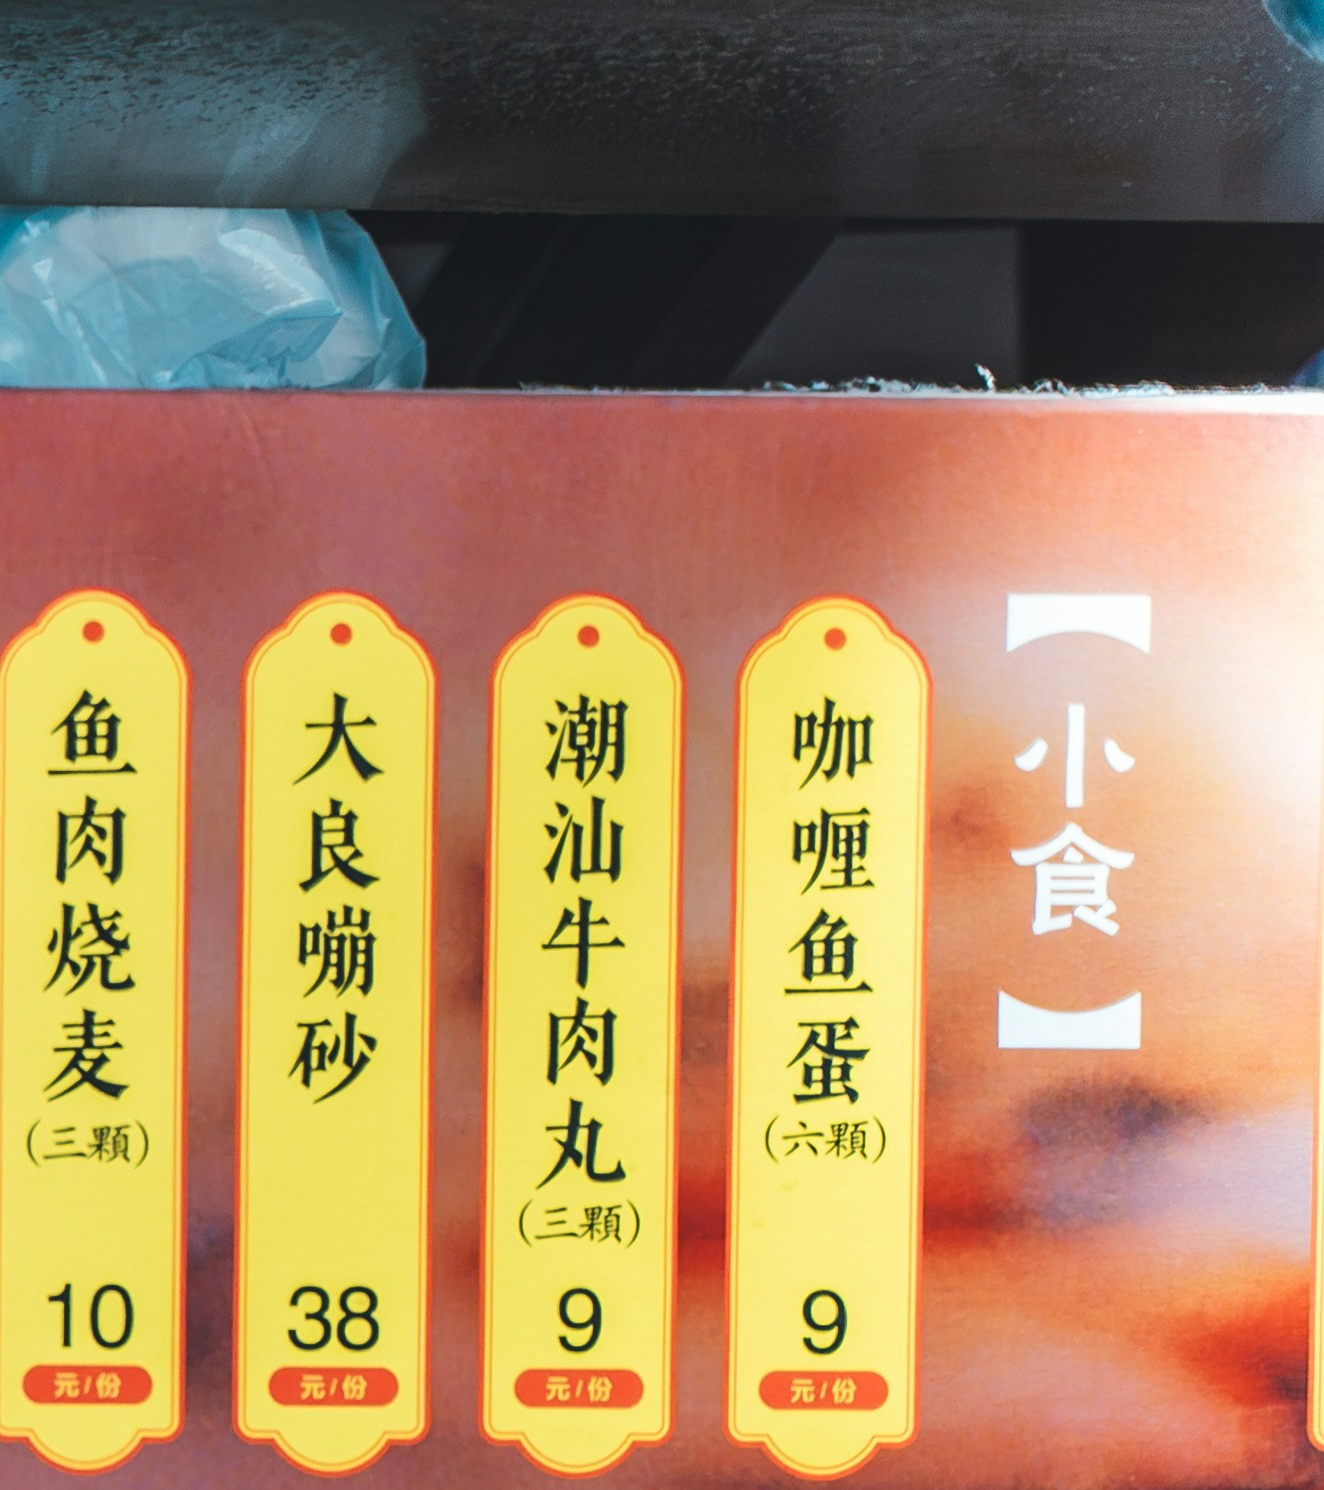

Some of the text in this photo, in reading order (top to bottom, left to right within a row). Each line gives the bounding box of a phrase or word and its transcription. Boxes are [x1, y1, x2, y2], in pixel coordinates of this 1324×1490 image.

[45, 689, 137, 1101] 鱼肉烧麦
[289, 692, 383, 1103] 大良嘣砂
[784, 697, 874, 1104] 咖喱鱼蛋
[537, 694, 629, 1189] 潮汕牛肉丸
[48, 1283, 134, 1350] 10
[287, 1285, 380, 1352] 38
[558, 1287, 602, 1353] 9
[802, 1289, 848, 1355] 9
[54, 1372, 122, 1398] 元/份
[300, 1374, 368, 1401] 元/份
[546, 1377, 613, 1402] 元/份
[791, 1379, 857, 1405] 元/份
